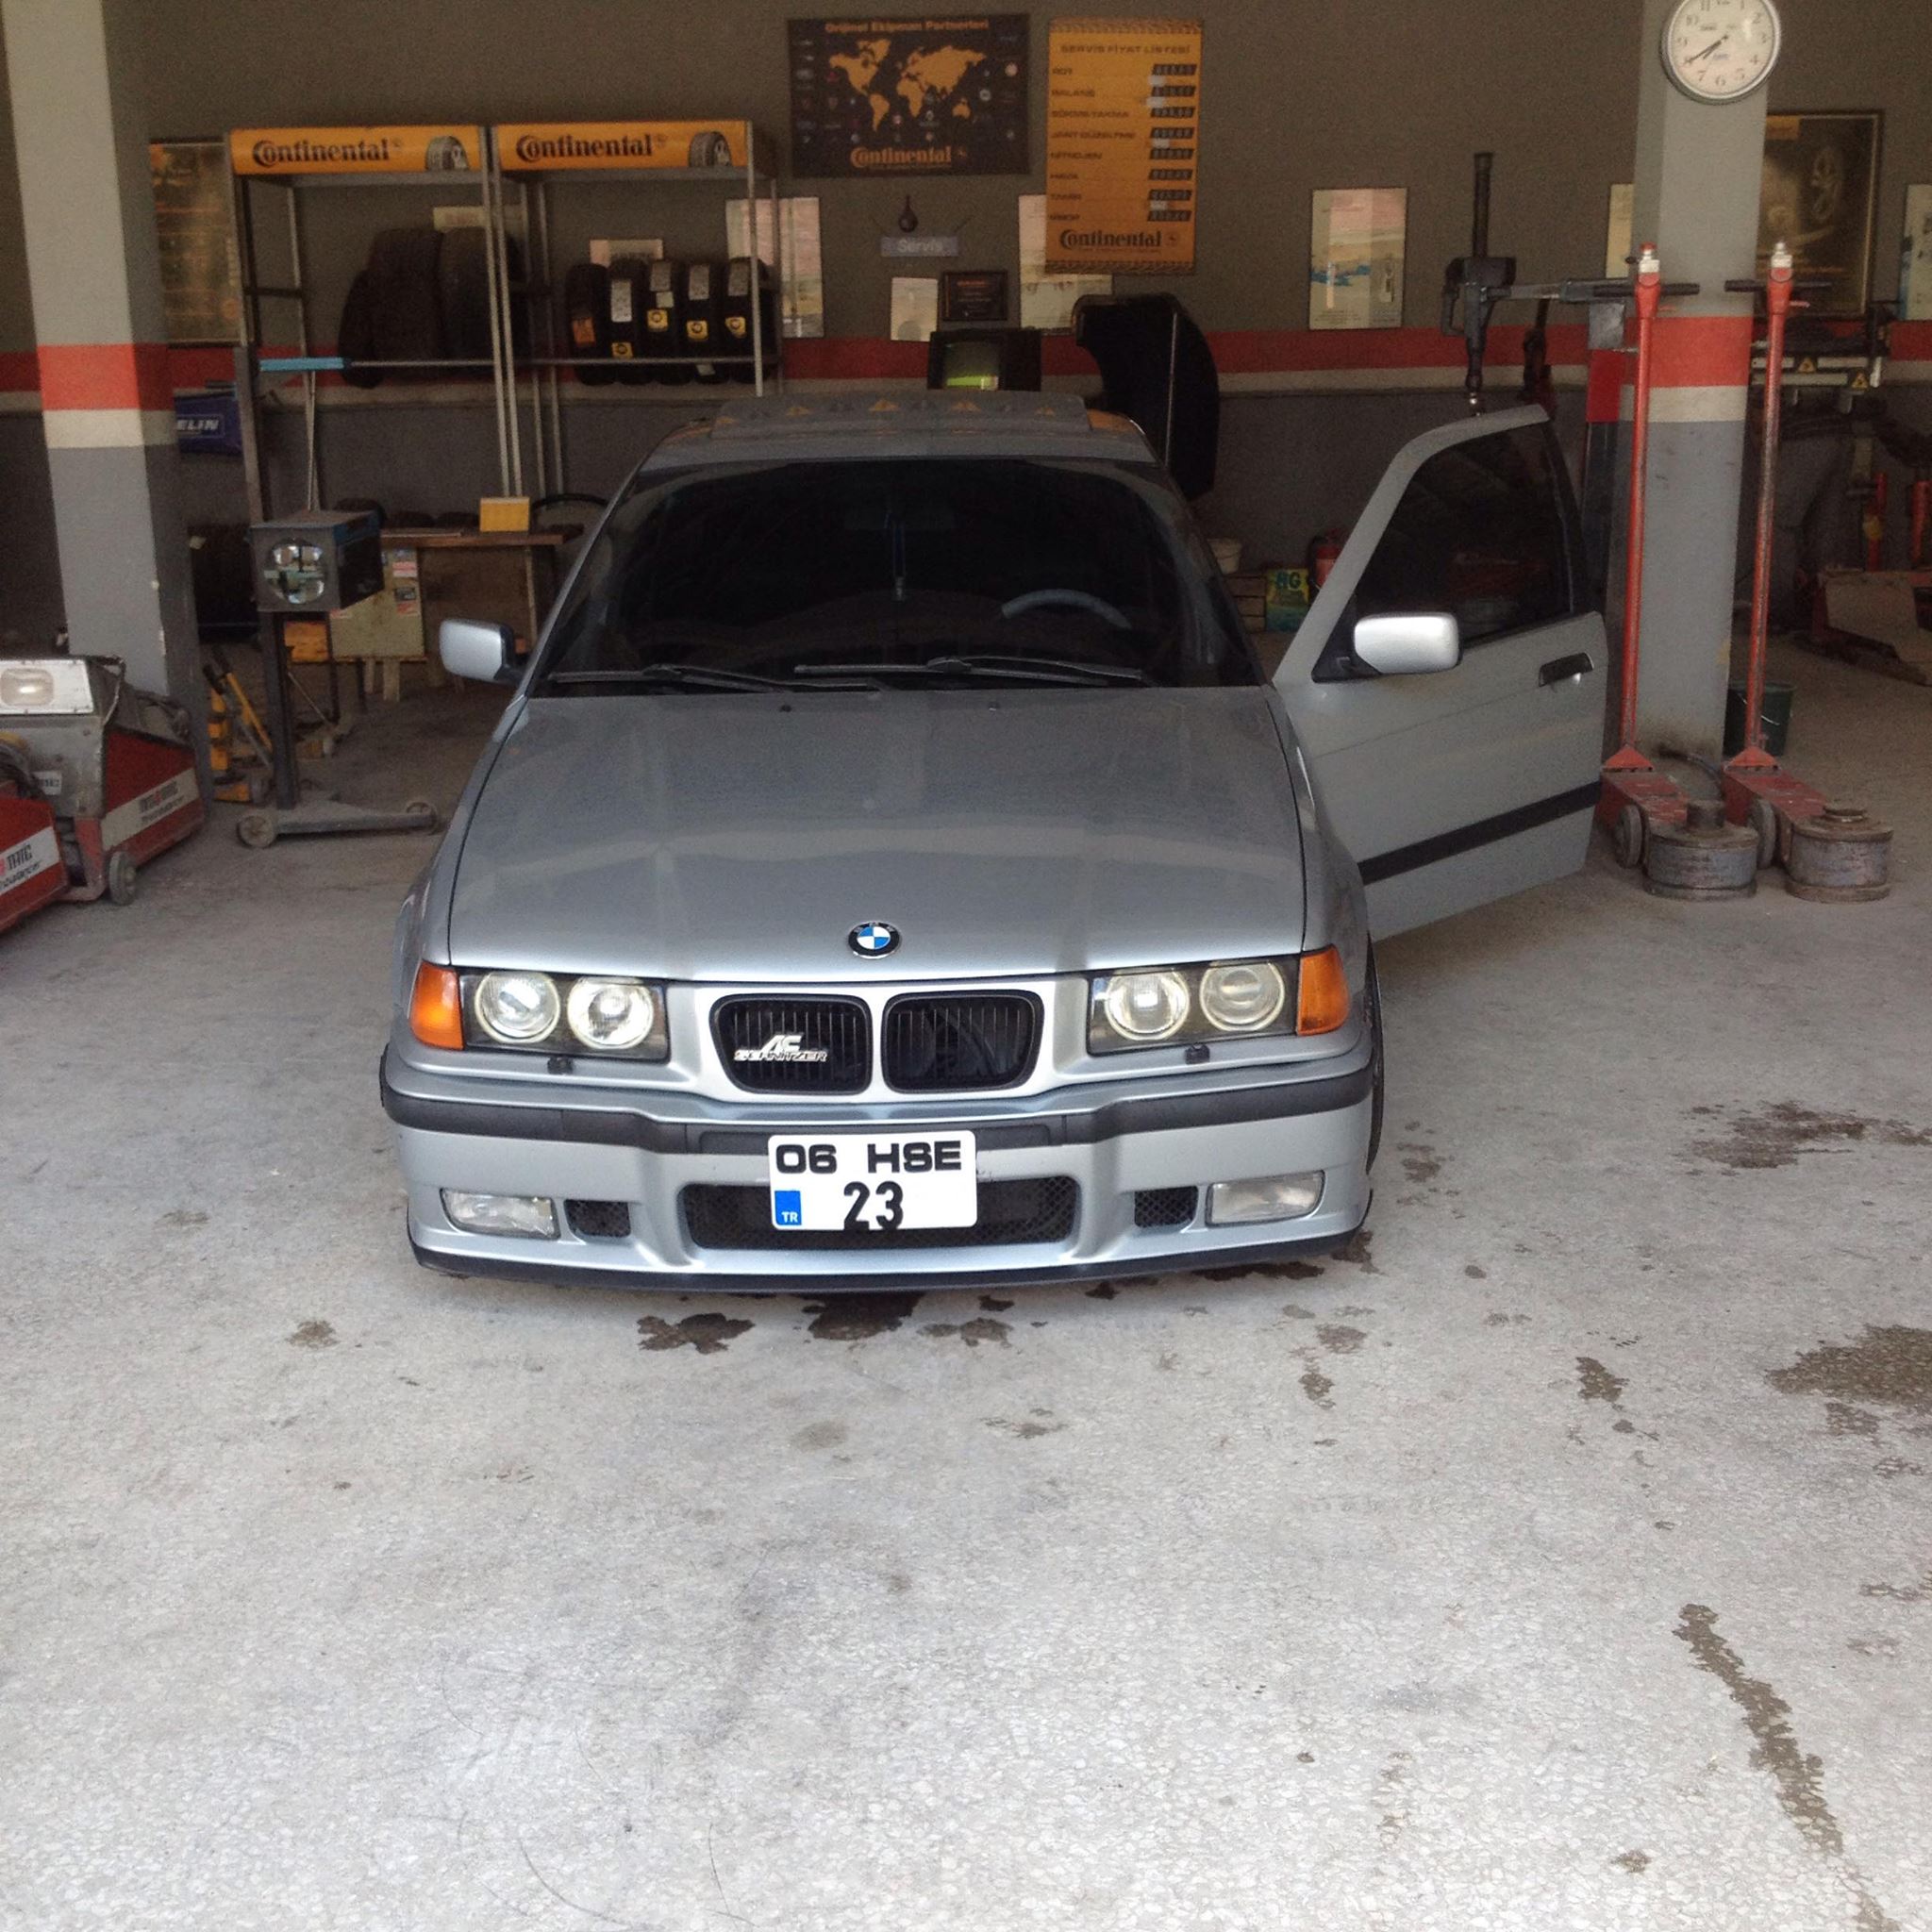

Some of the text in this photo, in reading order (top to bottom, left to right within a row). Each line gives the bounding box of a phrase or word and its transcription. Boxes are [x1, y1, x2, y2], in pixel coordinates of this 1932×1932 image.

[253, 139, 390, 167] Continental
[516, 134, 653, 163] Continental
[851, 145, 952, 168] Continental
[1059, 229, 1162, 250] Continental
[775, 1141, 961, 1174] 06 HSE
[782, 1211, 798, 1223] TR
[844, 1181, 903, 1229] 23
